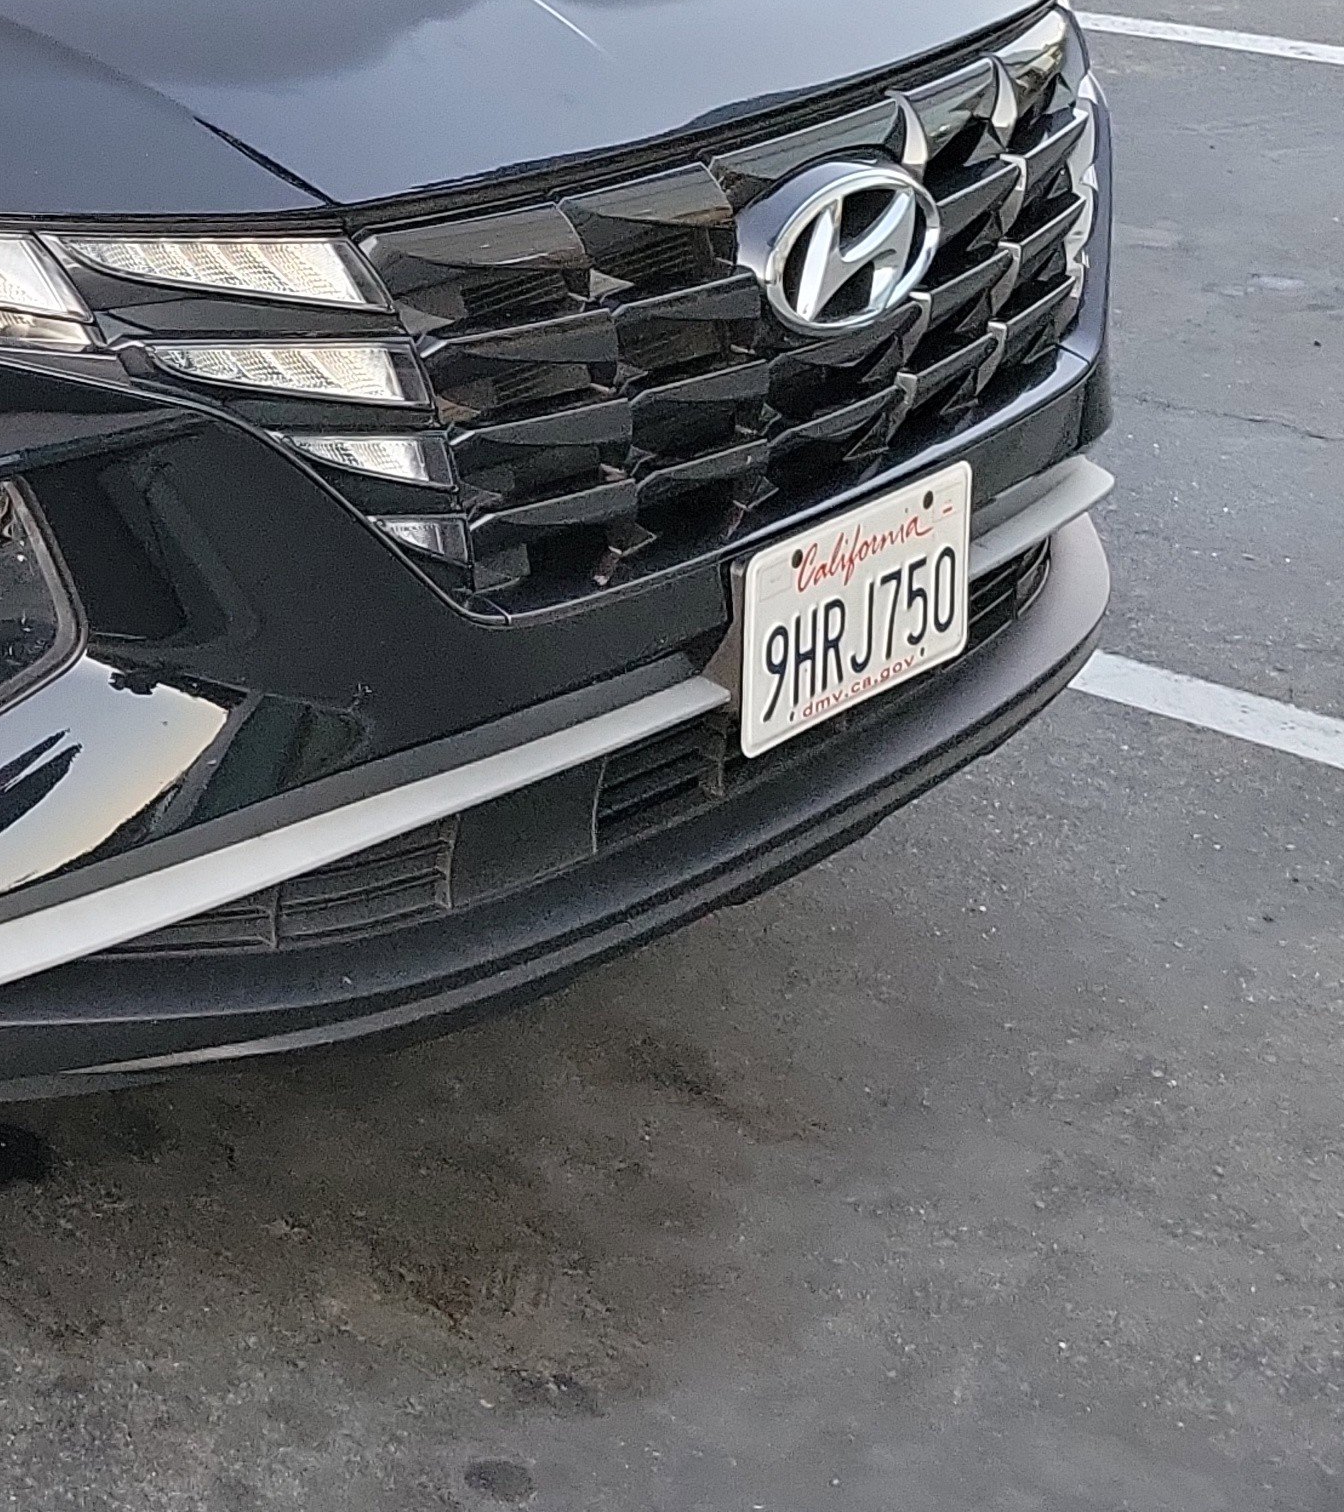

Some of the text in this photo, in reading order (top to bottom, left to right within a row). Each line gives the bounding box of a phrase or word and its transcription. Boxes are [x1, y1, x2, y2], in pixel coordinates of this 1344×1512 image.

[796, 510, 934, 593] California
[762, 545, 956, 723] 9HRJ750
[802, 654, 915, 719] dmv.ca.gov
